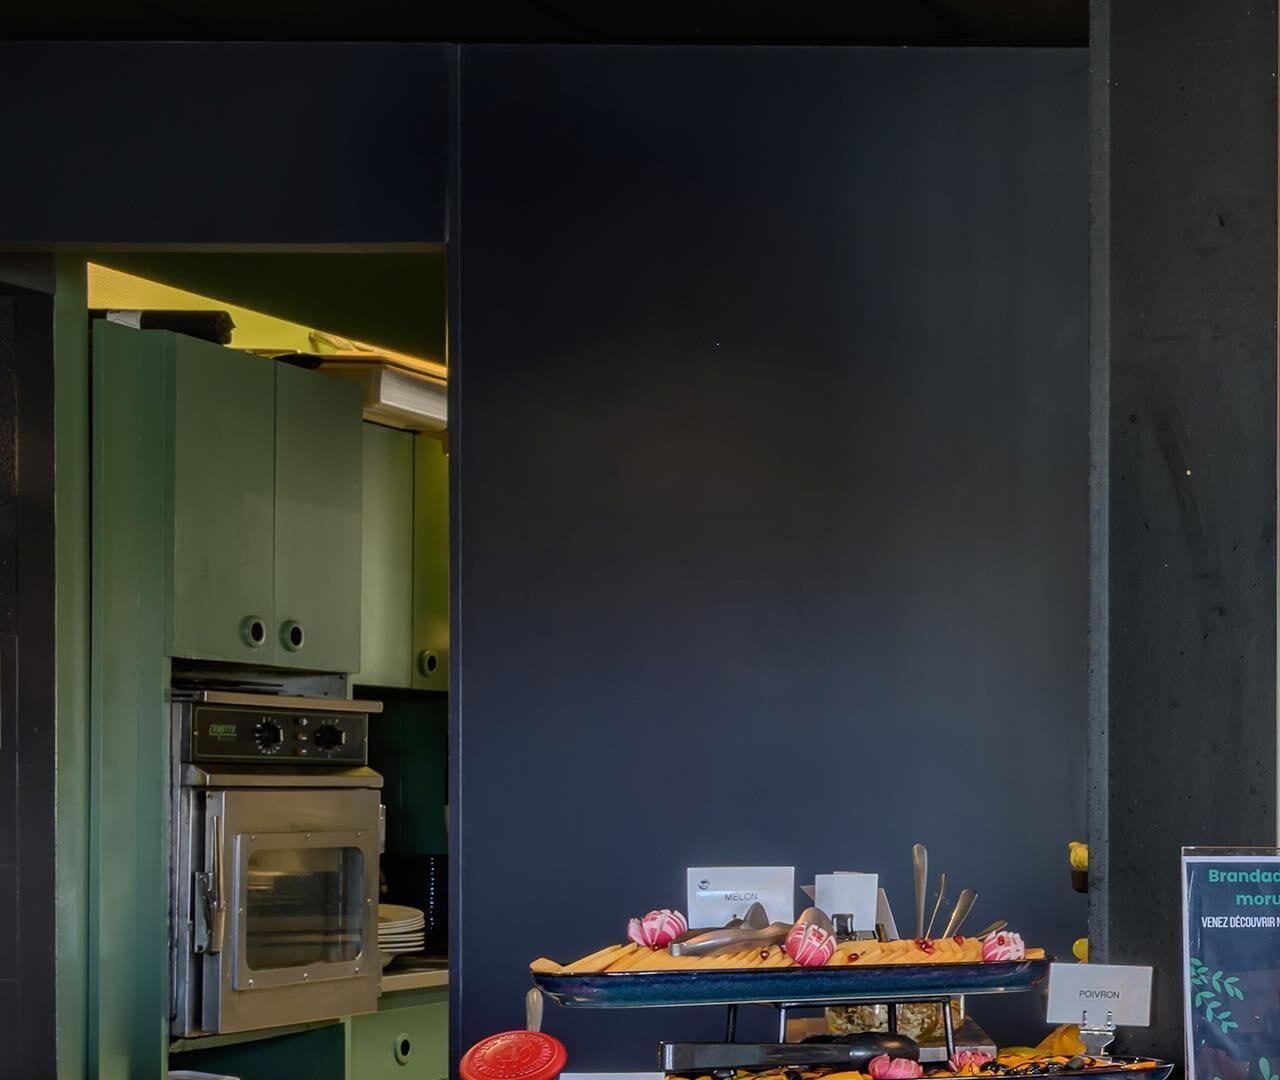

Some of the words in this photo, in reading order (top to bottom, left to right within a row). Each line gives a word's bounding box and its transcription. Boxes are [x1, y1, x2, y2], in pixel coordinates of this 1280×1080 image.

[725, 892, 758, 901] MELON
[1201, 916, 1228, 928] VENEZ
[1229, 914, 1276, 928] DÉCOUVRIR
[1079, 990, 1120, 999] POIVRON
